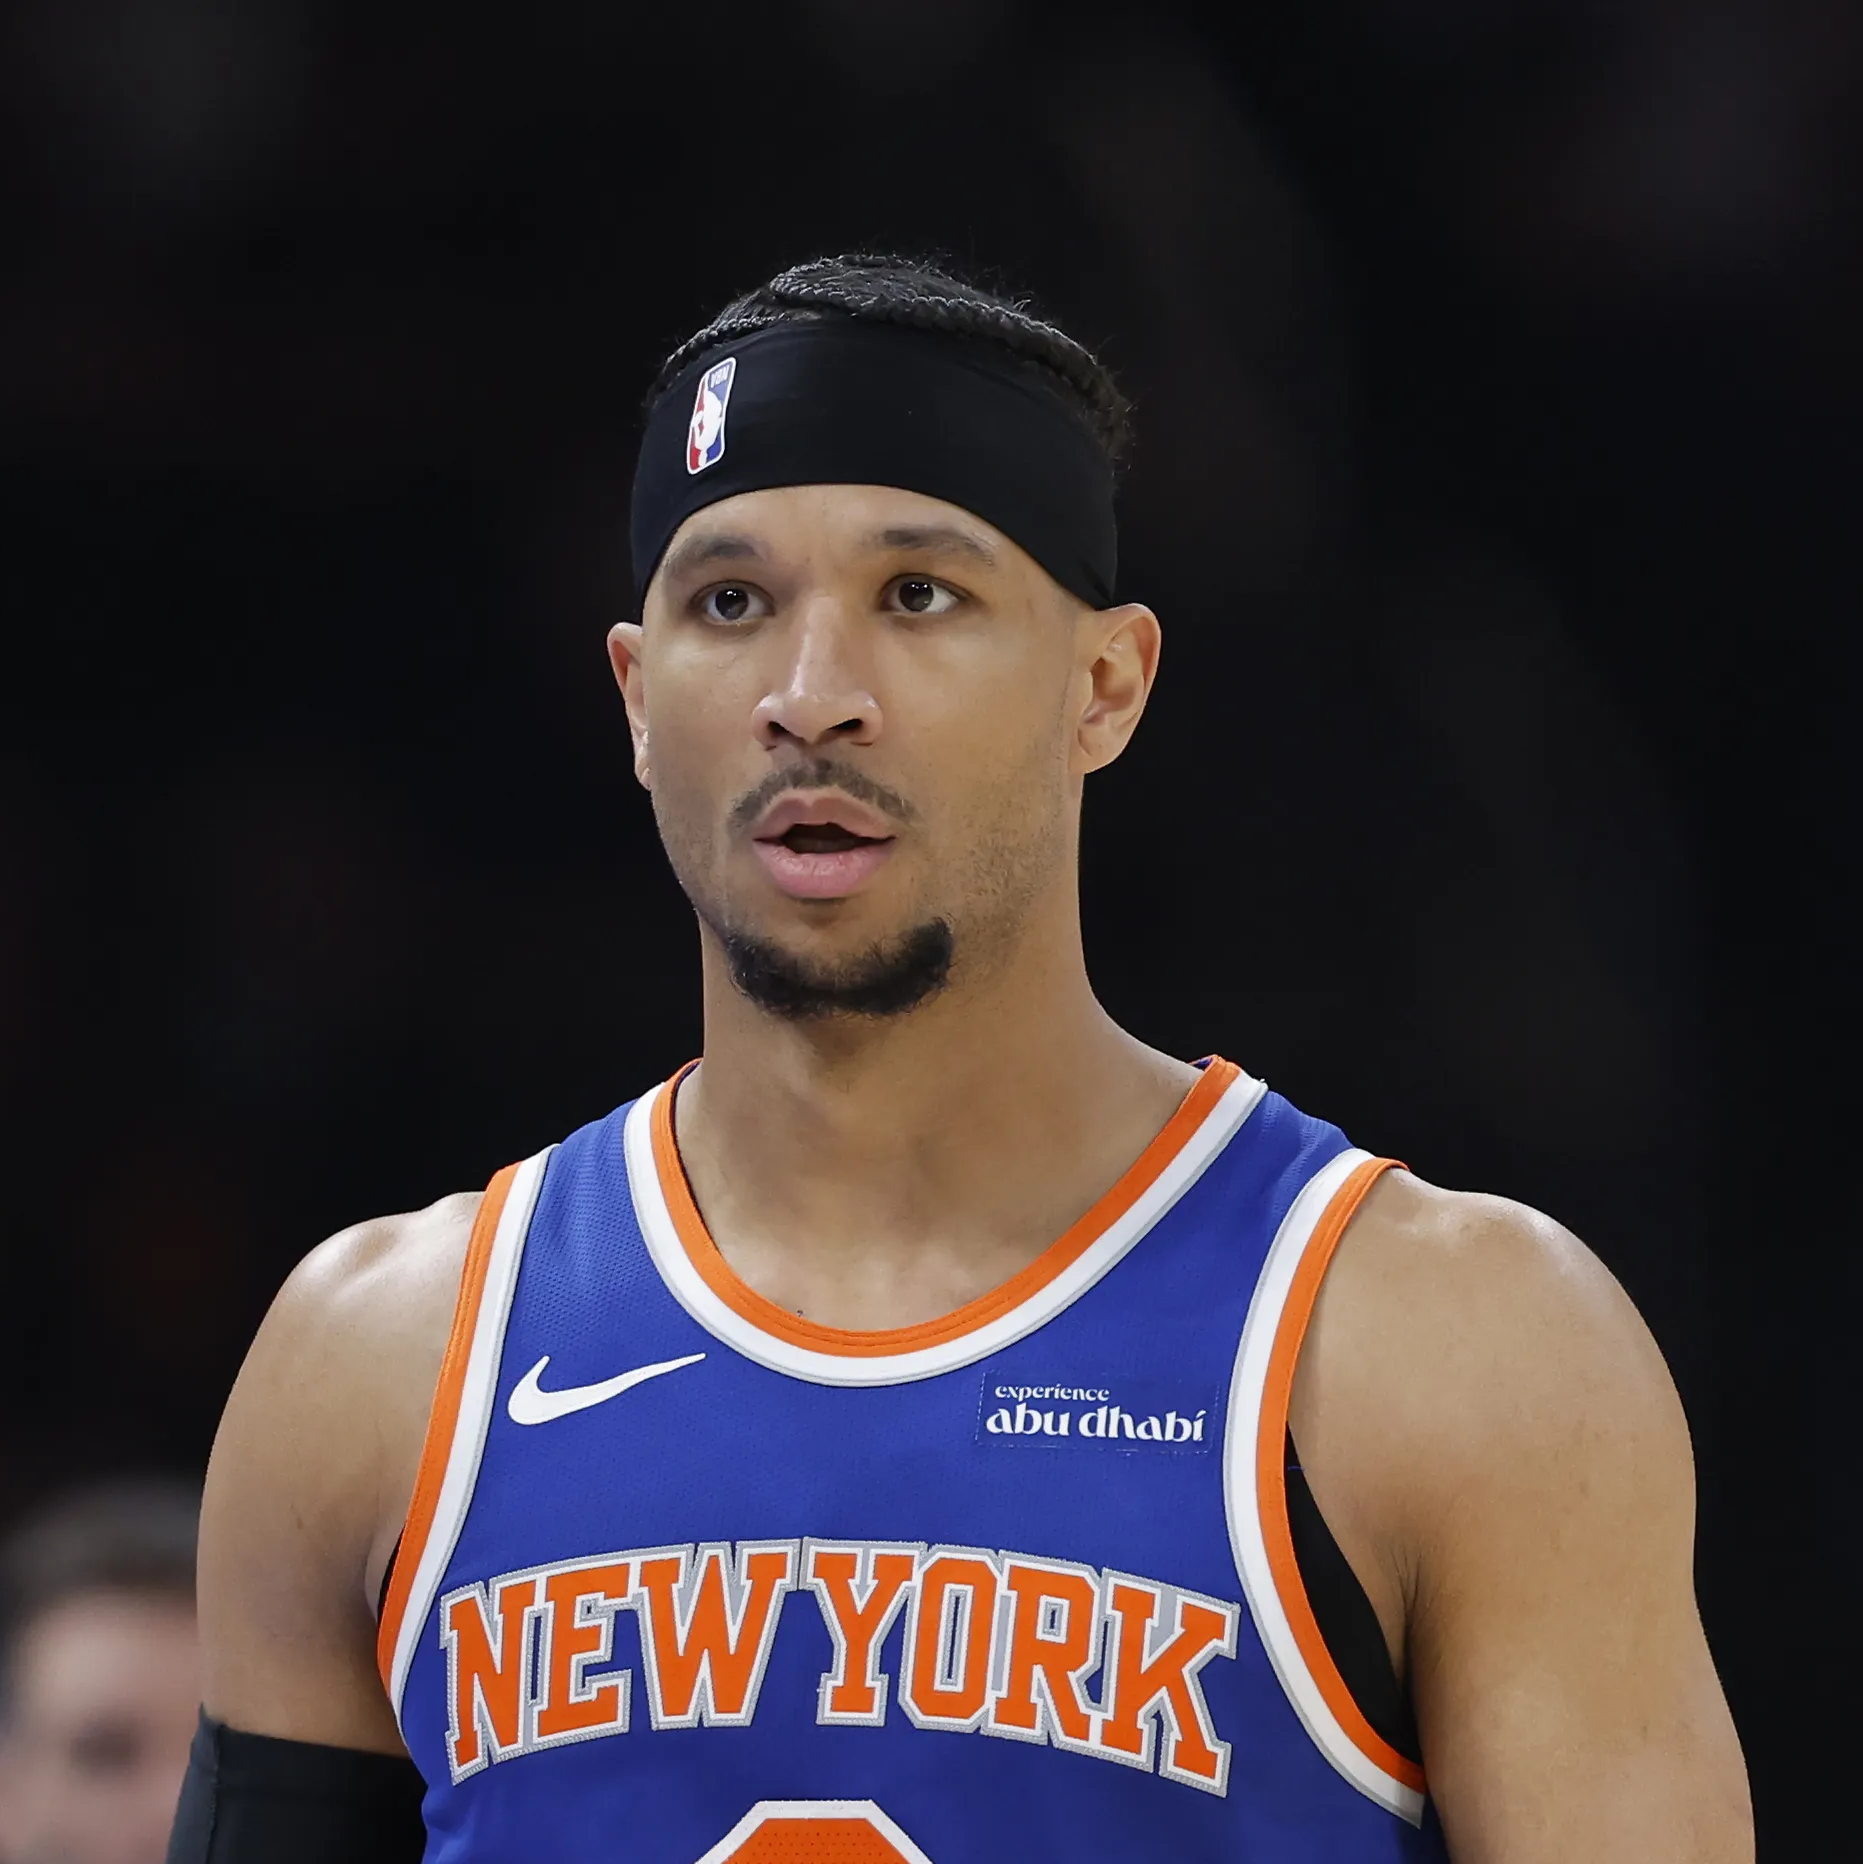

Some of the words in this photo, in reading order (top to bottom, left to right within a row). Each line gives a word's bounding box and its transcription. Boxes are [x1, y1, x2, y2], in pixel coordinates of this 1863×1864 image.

[994, 1383, 1111, 1402] experience
[986, 1402, 1071, 1436] abu
[1078, 1405, 1207, 1442] dhabi
[439, 1537, 802, 1786] NEW
[798, 1536, 1241, 1798] YORK
